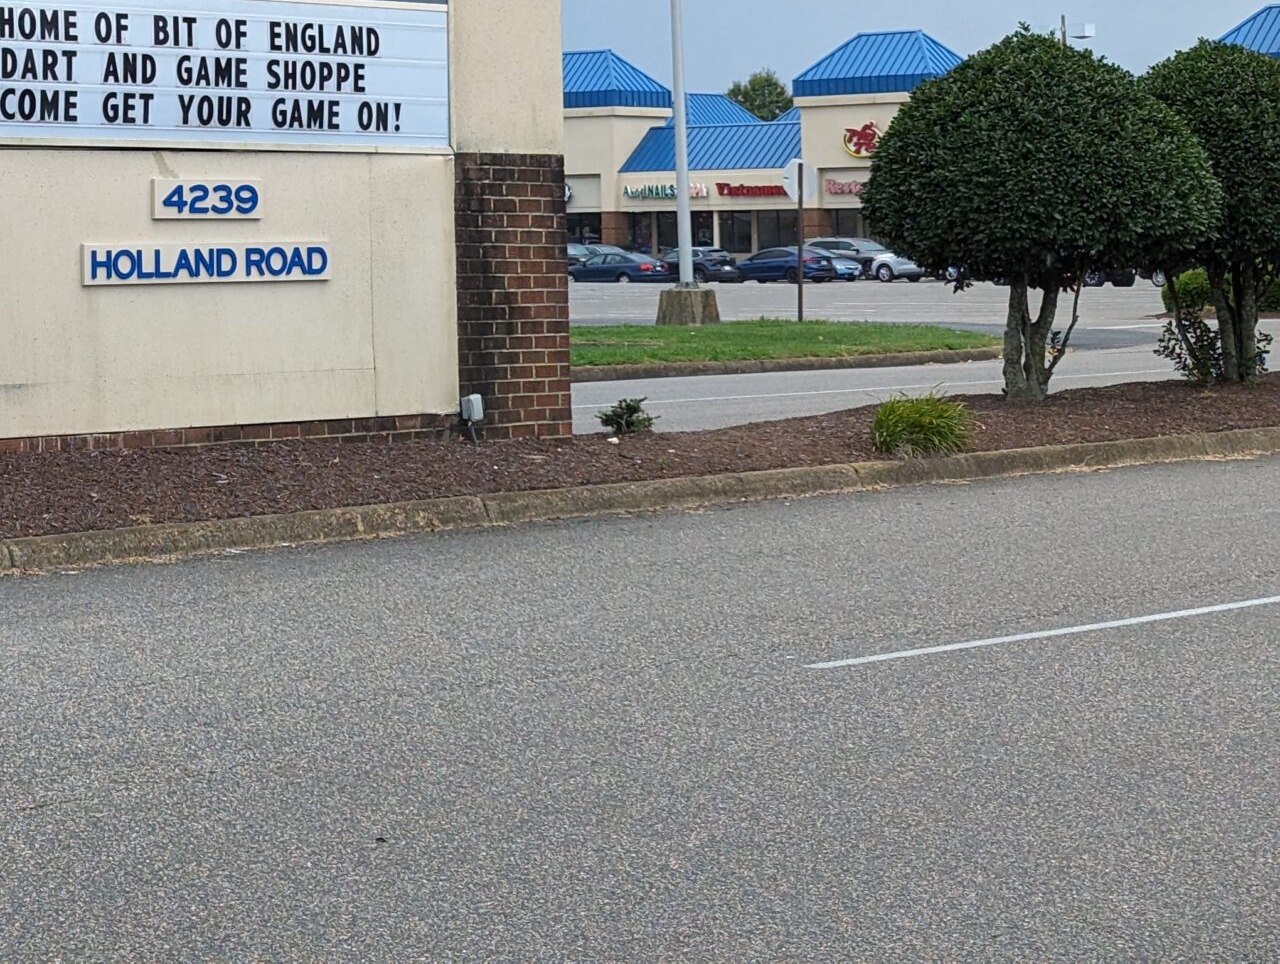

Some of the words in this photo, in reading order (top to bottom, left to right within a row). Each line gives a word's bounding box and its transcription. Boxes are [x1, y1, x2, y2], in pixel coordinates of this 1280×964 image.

[94, 11, 129, 44] OF
[153, 14, 197, 48] BIT
[215, 18, 248, 50] OF
[268, 20, 380, 57] ENGLAND
[0, 47, 78, 82] DART
[103, 51, 157, 85] AND
[176, 54, 248, 88] GAME
[266, 59, 366, 93] SHOPPE
[0, 87, 79, 122] COME
[102, 91, 155, 125] GET
[178, 94, 252, 128] YOUR
[271, 97, 341, 131] GAME
[357, 100, 402, 133] ON!
[162, 184, 259, 215] 4239
[647, 184, 677, 197] NAILS
[90, 248, 238, 280] HOLLAND
[244, 246, 328, 277] ROAD
